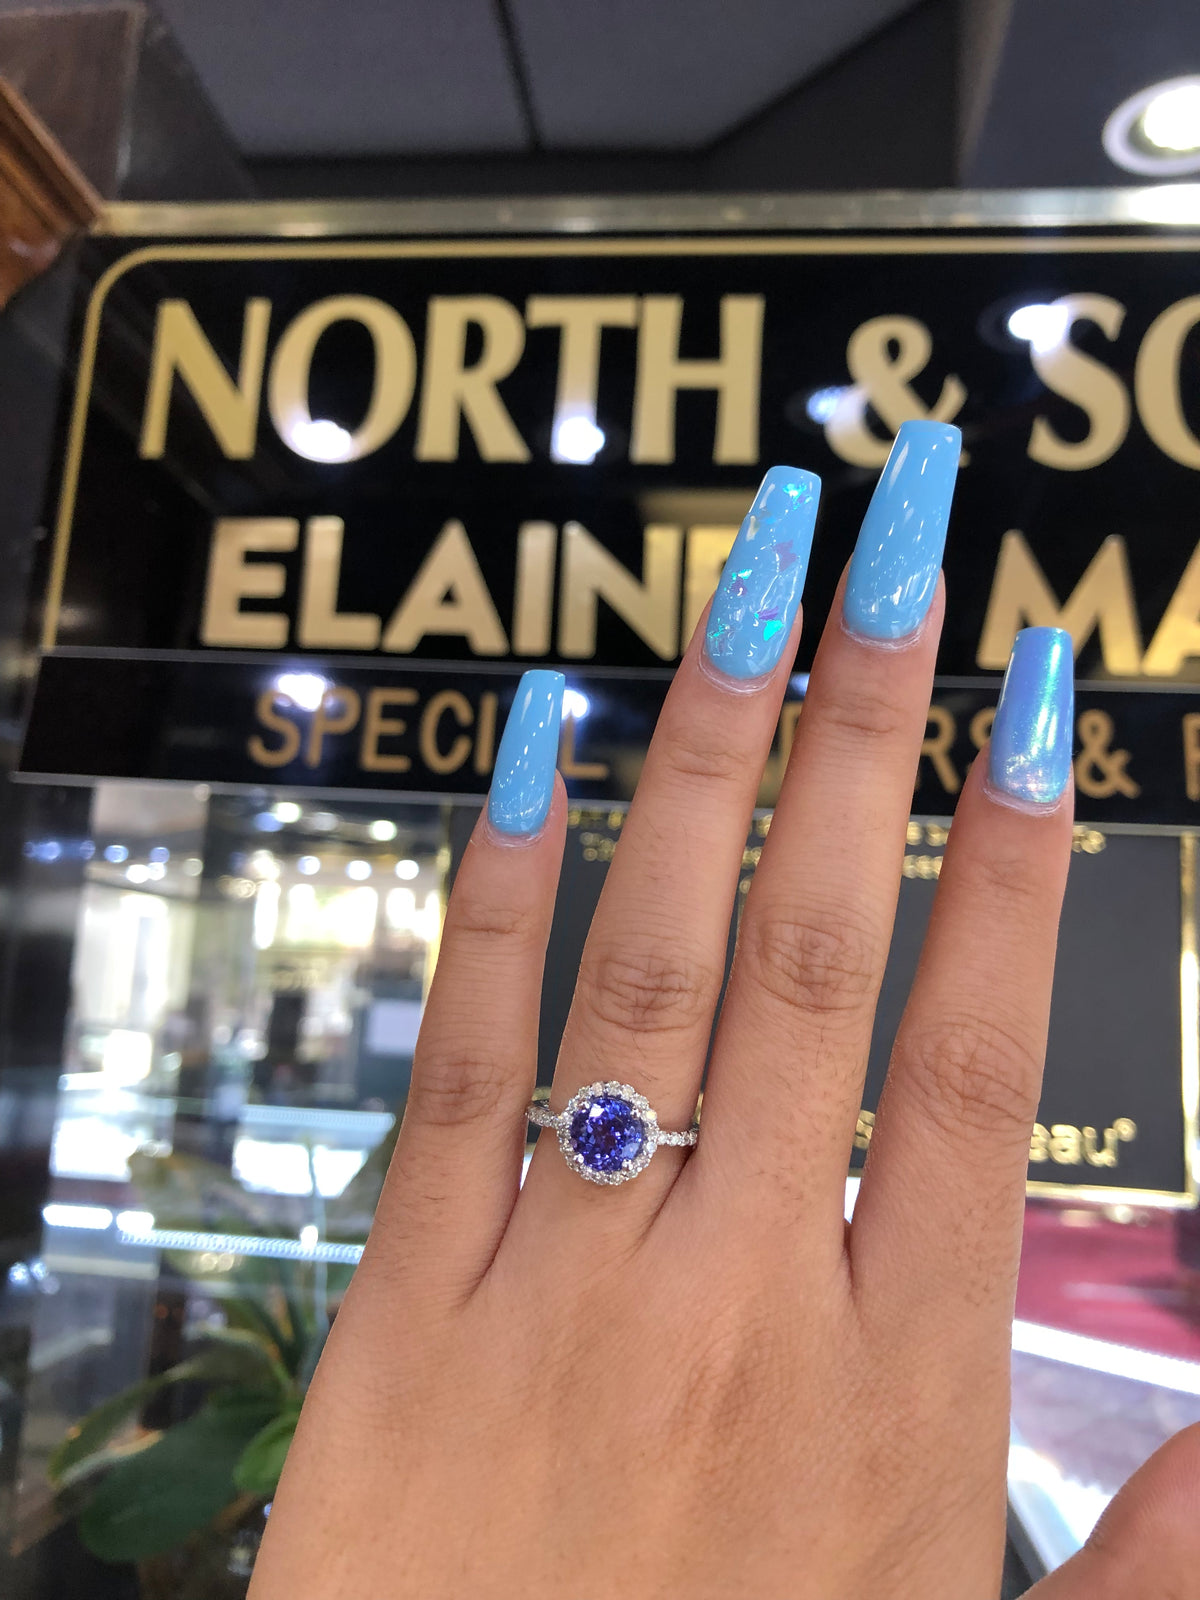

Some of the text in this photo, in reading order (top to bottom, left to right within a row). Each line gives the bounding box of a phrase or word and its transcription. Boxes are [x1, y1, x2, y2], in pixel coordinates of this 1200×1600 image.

[138, 293, 766, 466] NORTH
[822, 314, 969, 470] &
[248, 684, 610, 781] SPECIL
[1072, 707, 1143, 800] &
